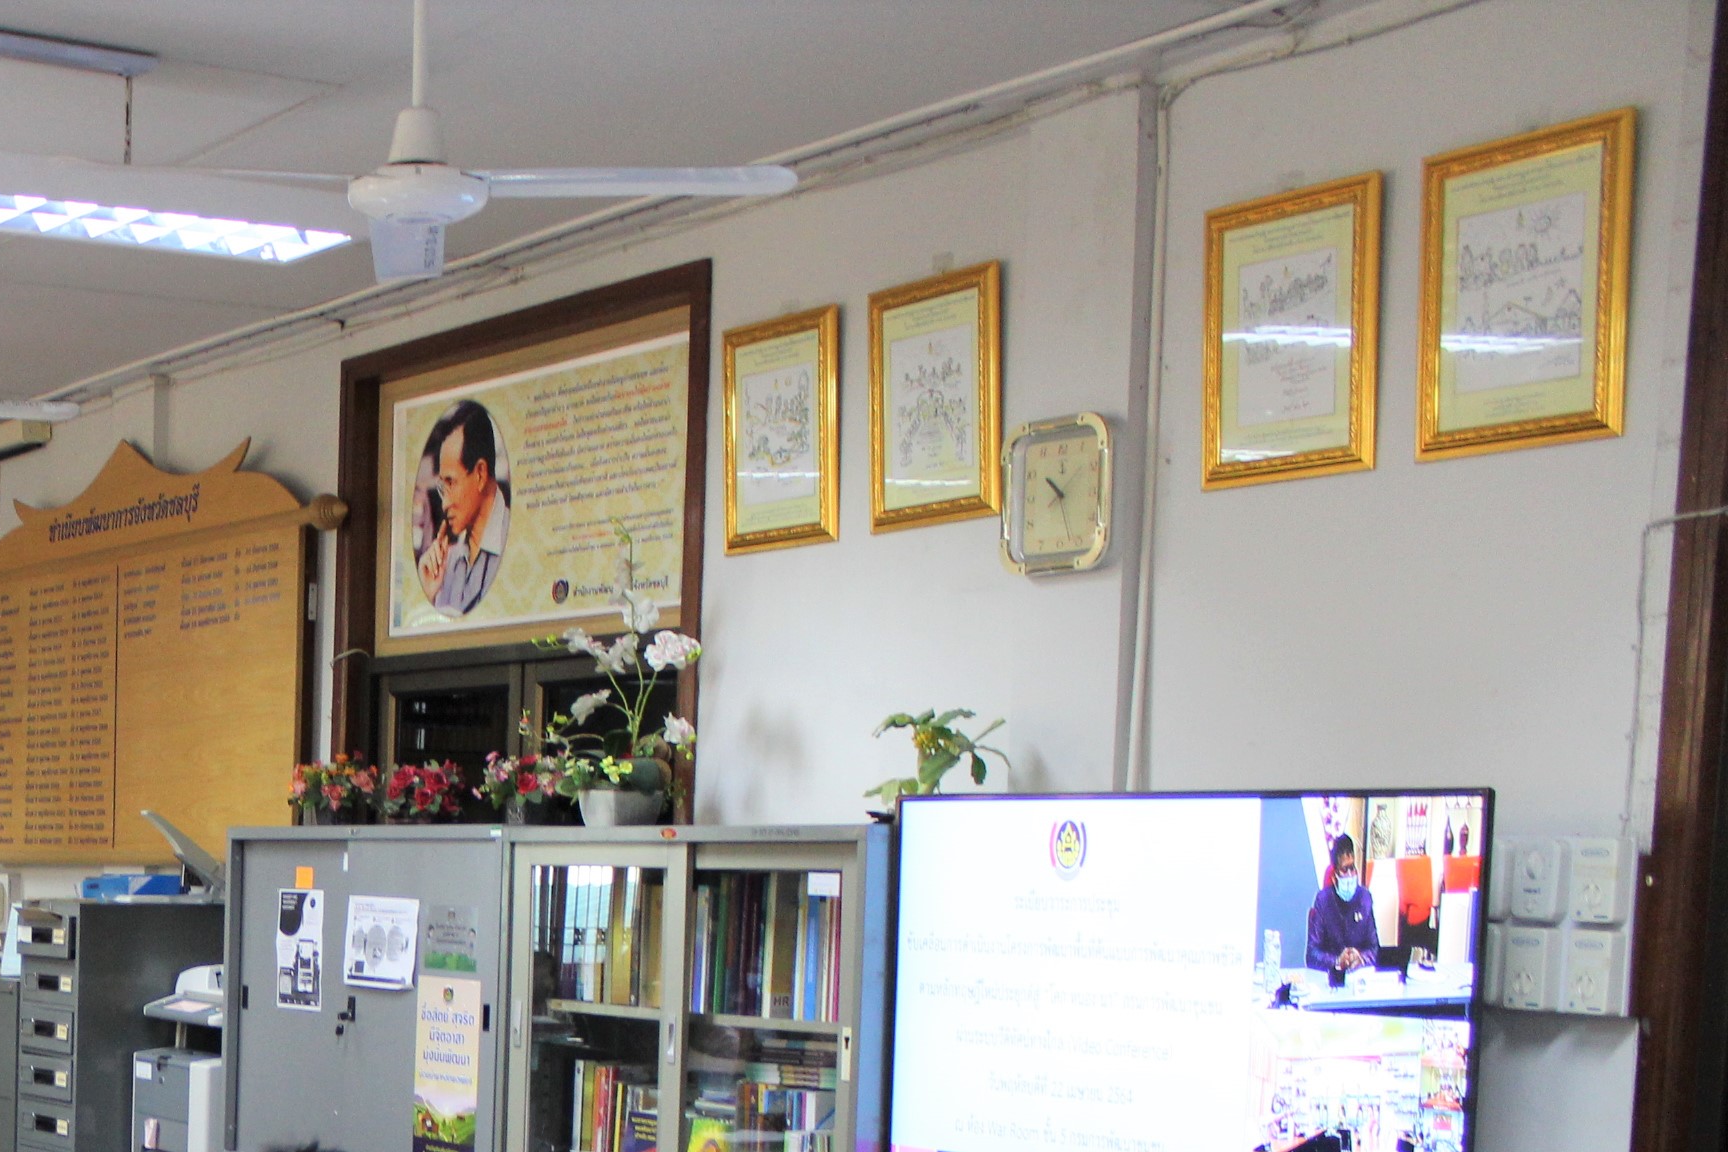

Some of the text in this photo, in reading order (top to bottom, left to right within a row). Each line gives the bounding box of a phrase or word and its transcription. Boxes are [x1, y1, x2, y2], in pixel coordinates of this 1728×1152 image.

[48, 482, 201, 543] ทำเนียบพัฒนาการจังหวัดชลบุรี
[773, 996, 789, 1006] HR
